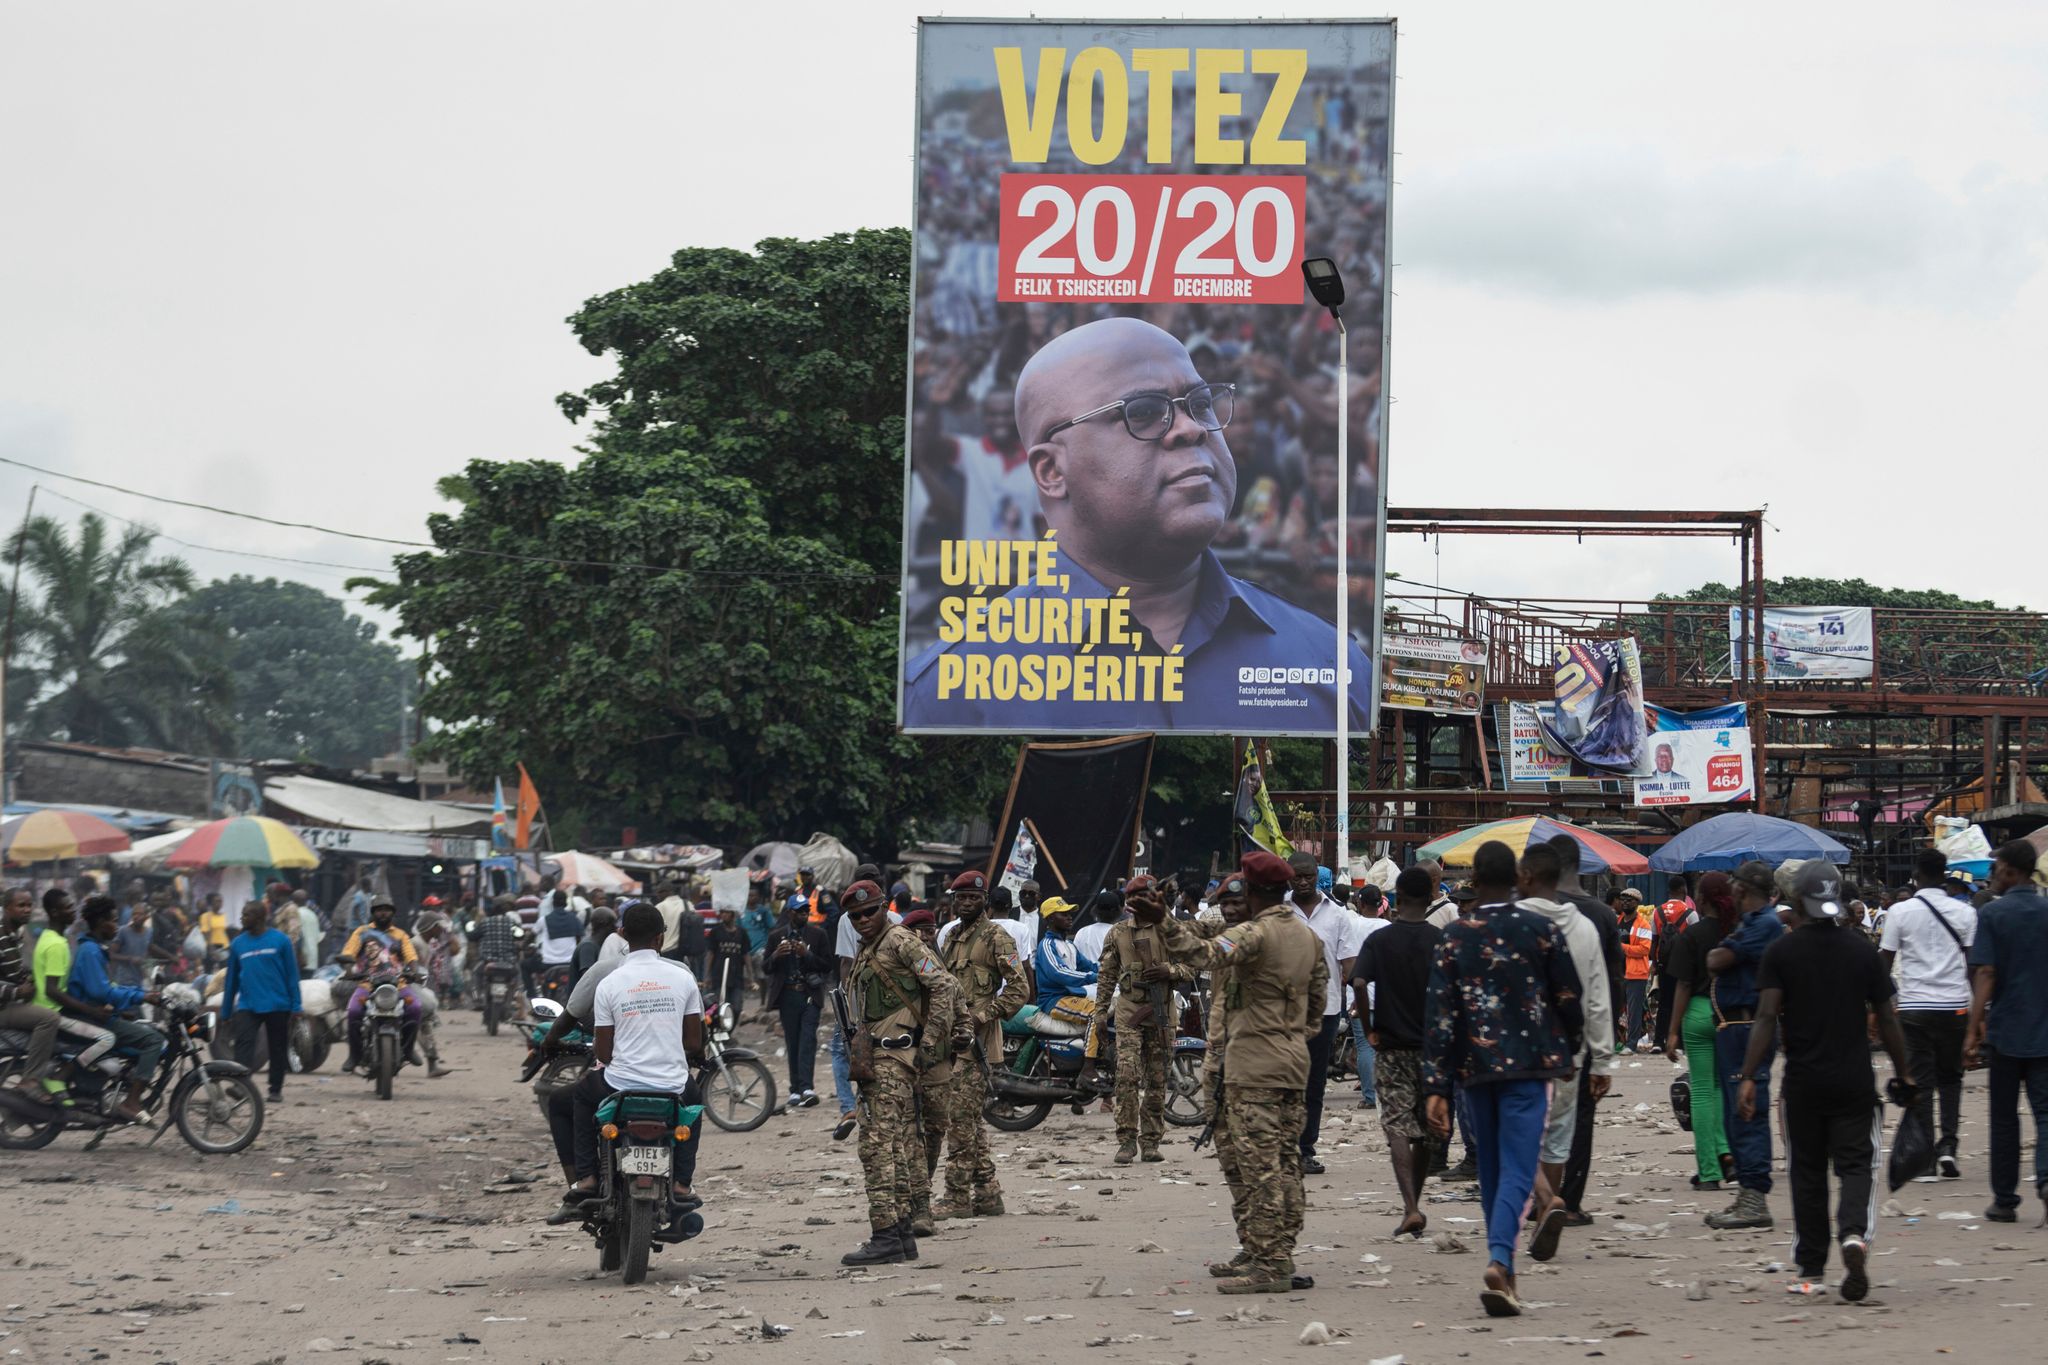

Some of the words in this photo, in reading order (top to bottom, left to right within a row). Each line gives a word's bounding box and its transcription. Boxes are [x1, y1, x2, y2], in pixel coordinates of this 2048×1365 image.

[993, 46, 1308, 165] VOTEZ
[1015, 185, 1295, 296] 20/20
[1015, 278, 1052, 296] FELIX
[1057, 279, 1136, 297] TSHISEKEDI
[1174, 278, 1252, 297] DECEMBRE
[940, 530, 1070, 593] UNITÉ,
[939, 586, 1142, 651] SÉCURITÉ,
[1818, 622, 1844, 635] 141
[1404, 637, 1443, 648] TSHANGU
[1385, 648, 1412, 657] VOTONS
[1413, 651, 1461, 661] MASSIVEMENT
[937, 643, 1184, 703] PROSPÉRITÉ
[1239, 686, 1257, 695] Fatshi
[1257, 686, 1286, 696] président
[1382, 683, 1402, 691] BUKA
[1403, 685, 1461, 698] KIBALANGUNDU
[1239, 698, 1308, 708] www.fatshipresident.cd
[1711, 761, 1741, 769] TSHANGU
[1640, 783, 1664, 792] NSIMBA
[1669, 781, 1691, 790] LUTETE
[1712, 775, 1740, 787] 464
[633, 1148, 658, 1159] 01EX
